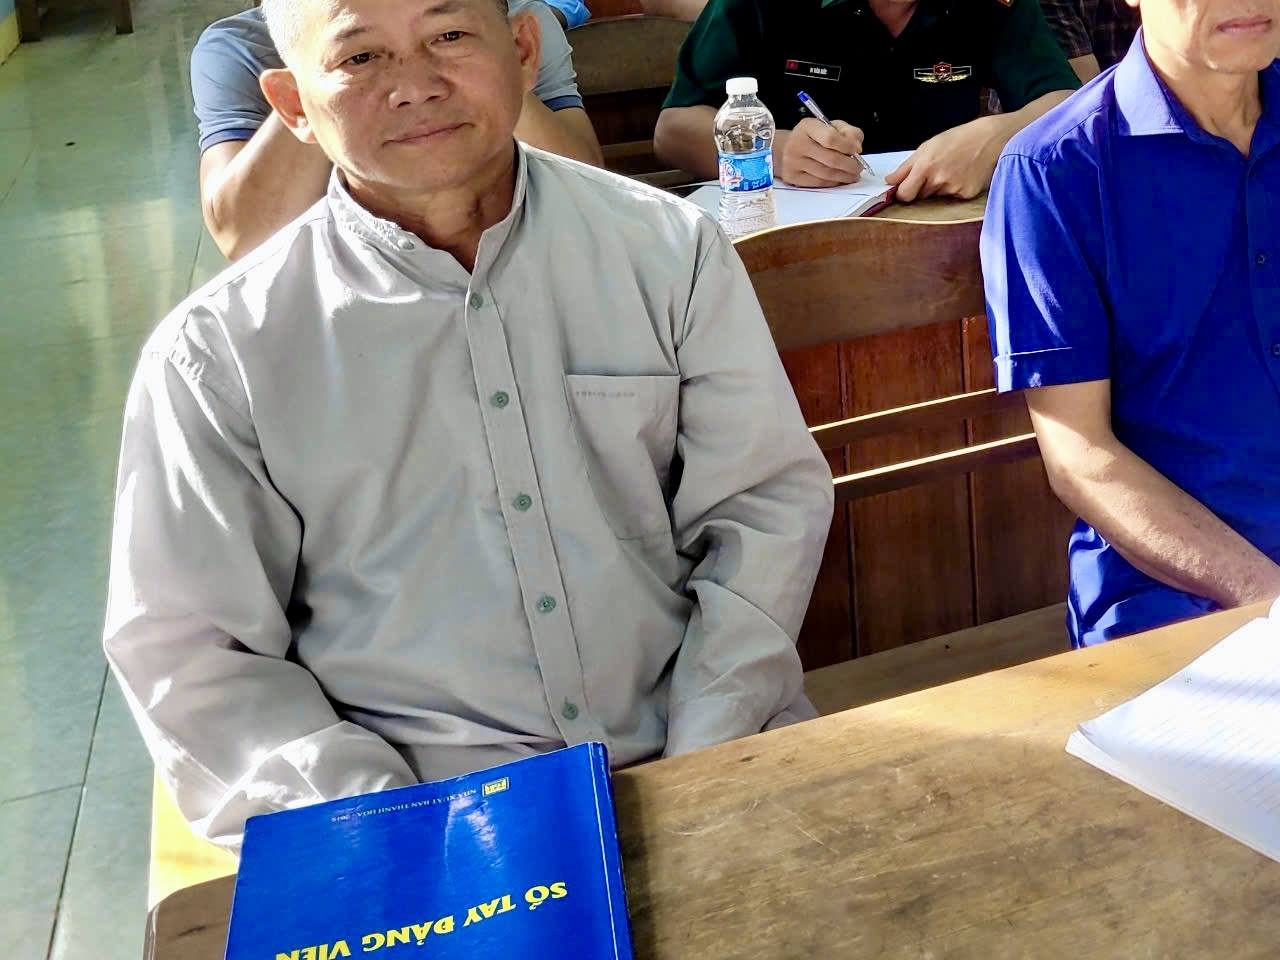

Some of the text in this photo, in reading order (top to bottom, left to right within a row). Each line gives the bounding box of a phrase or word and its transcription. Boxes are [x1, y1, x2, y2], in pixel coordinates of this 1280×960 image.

[463, 894, 516, 927] TAY
[524, 882, 568, 910] SỔ
[361, 915, 455, 952] ĐẢNG
